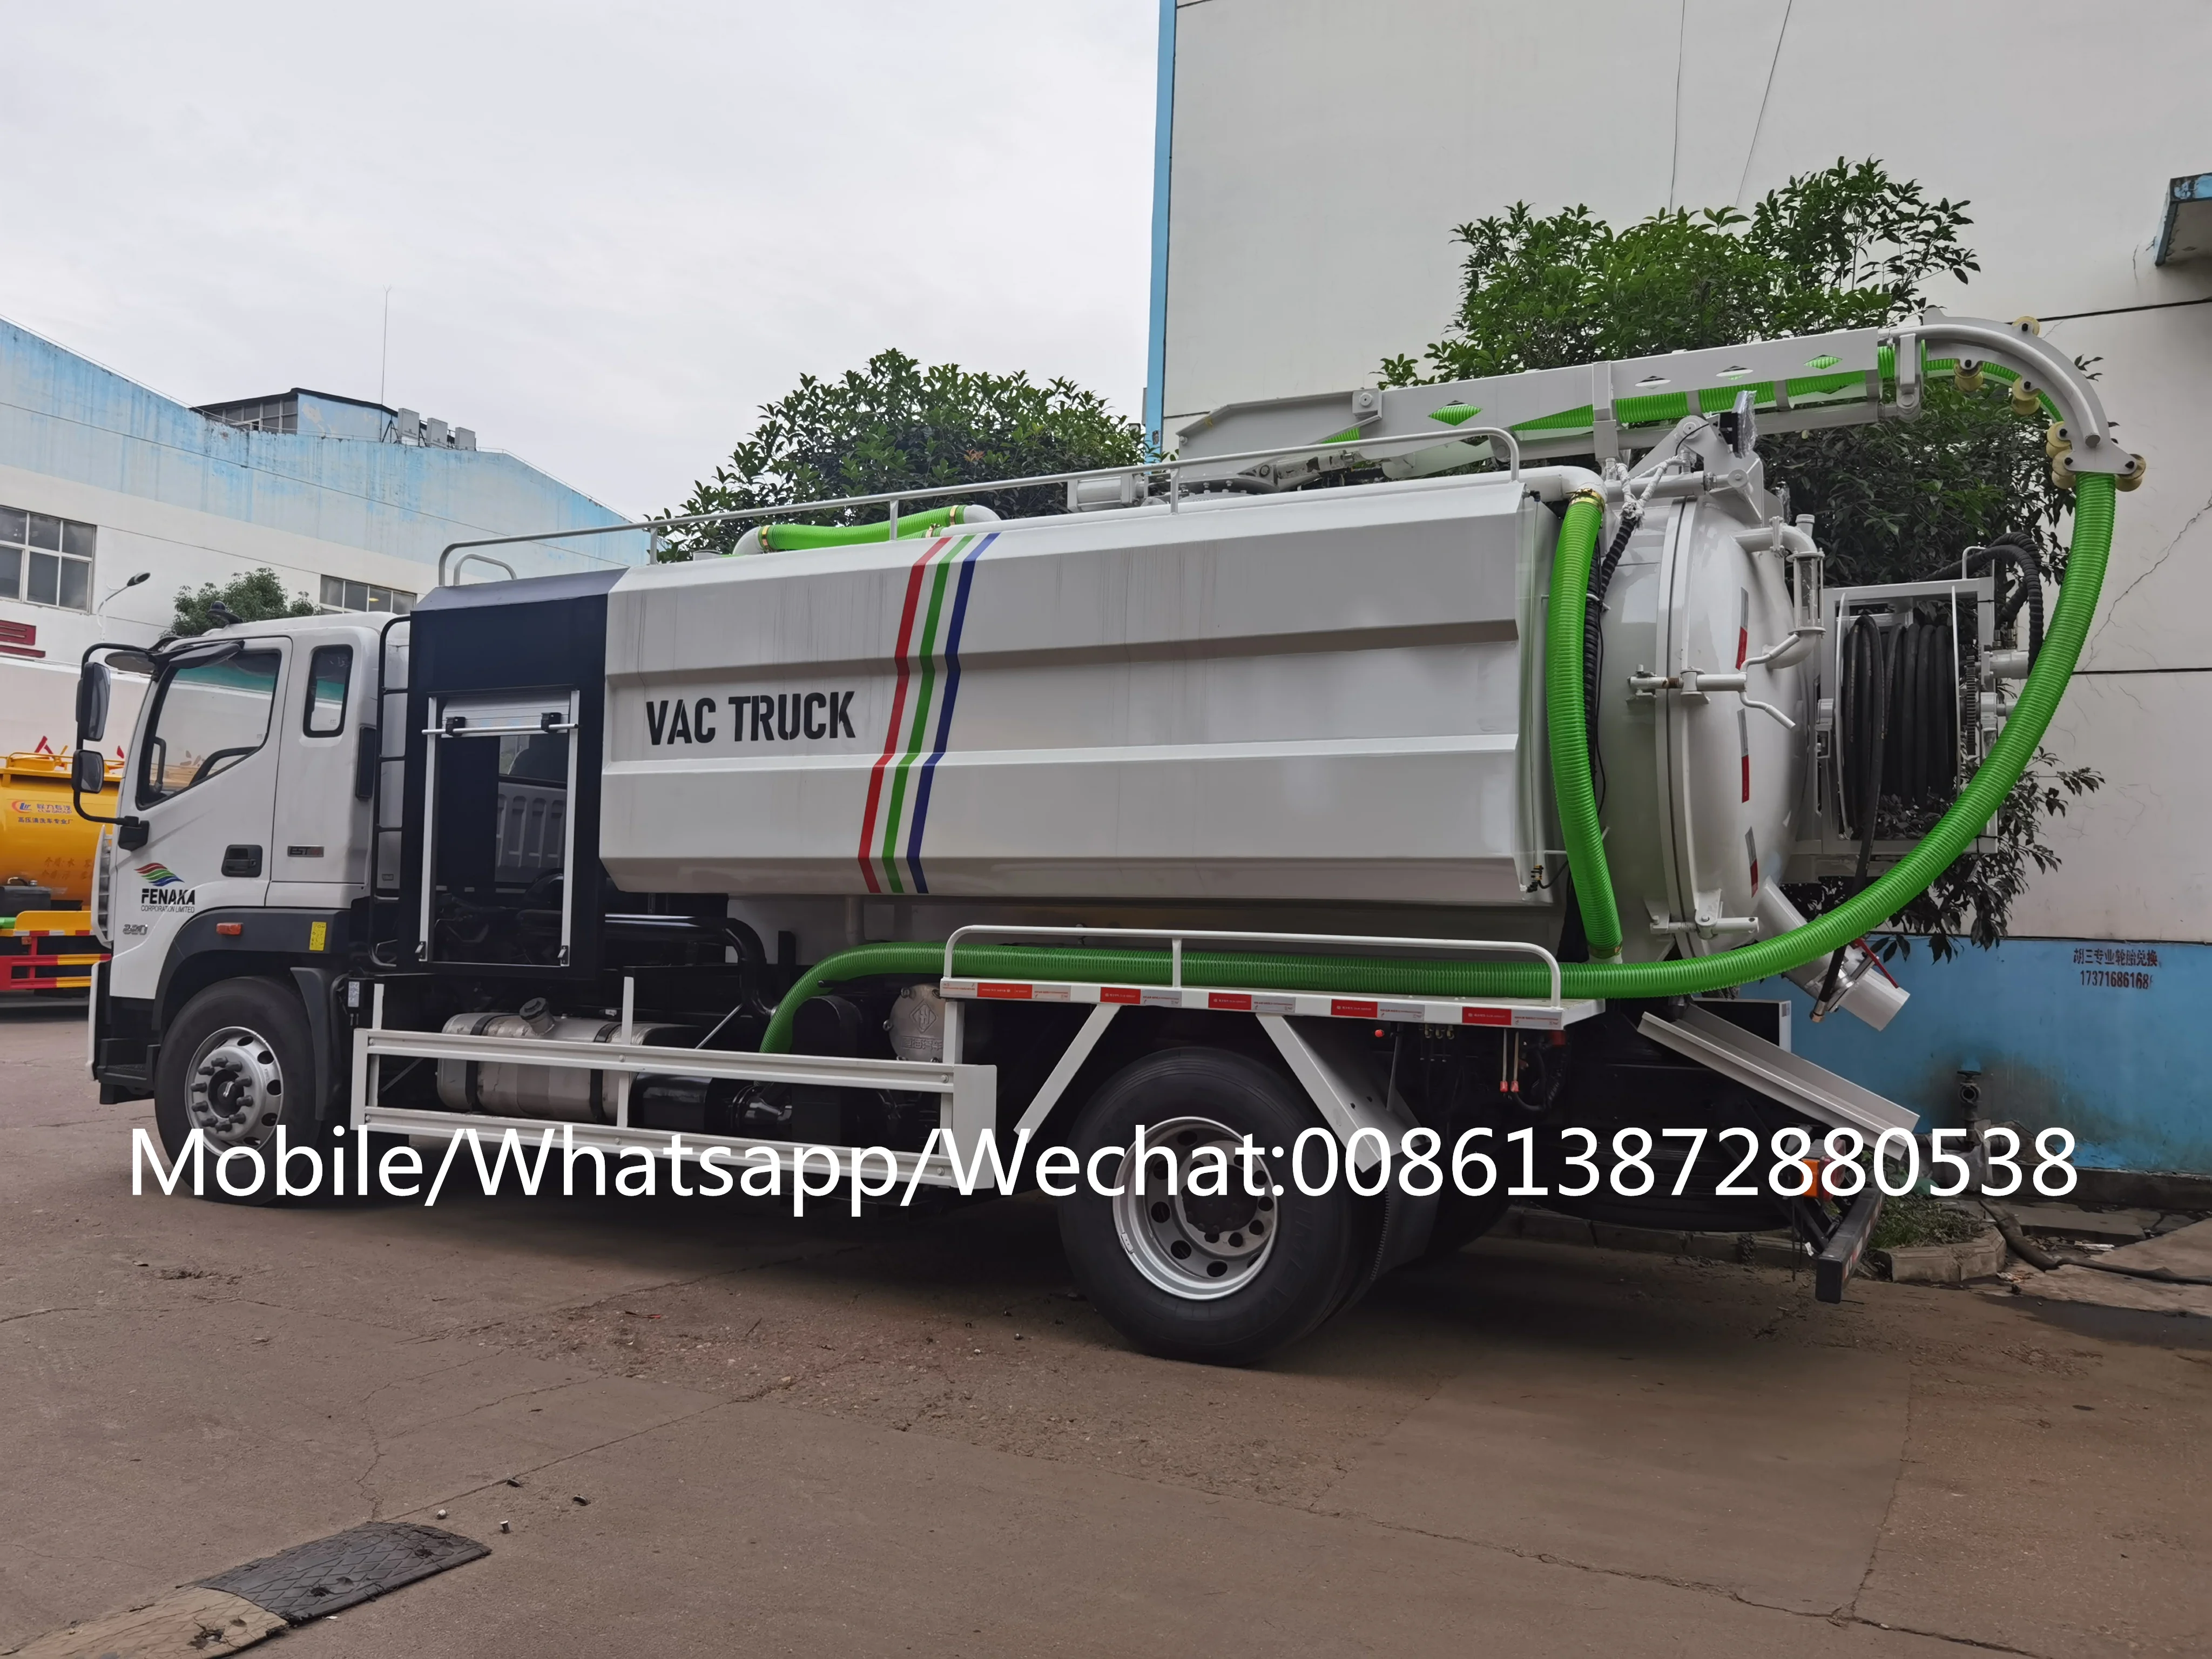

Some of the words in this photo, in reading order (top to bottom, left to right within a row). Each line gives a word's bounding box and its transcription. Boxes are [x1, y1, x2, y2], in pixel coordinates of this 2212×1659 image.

[646, 697, 716, 745] VAC
[728, 691, 857, 742] TRUCK
[141, 888, 195, 905] FENAKA
